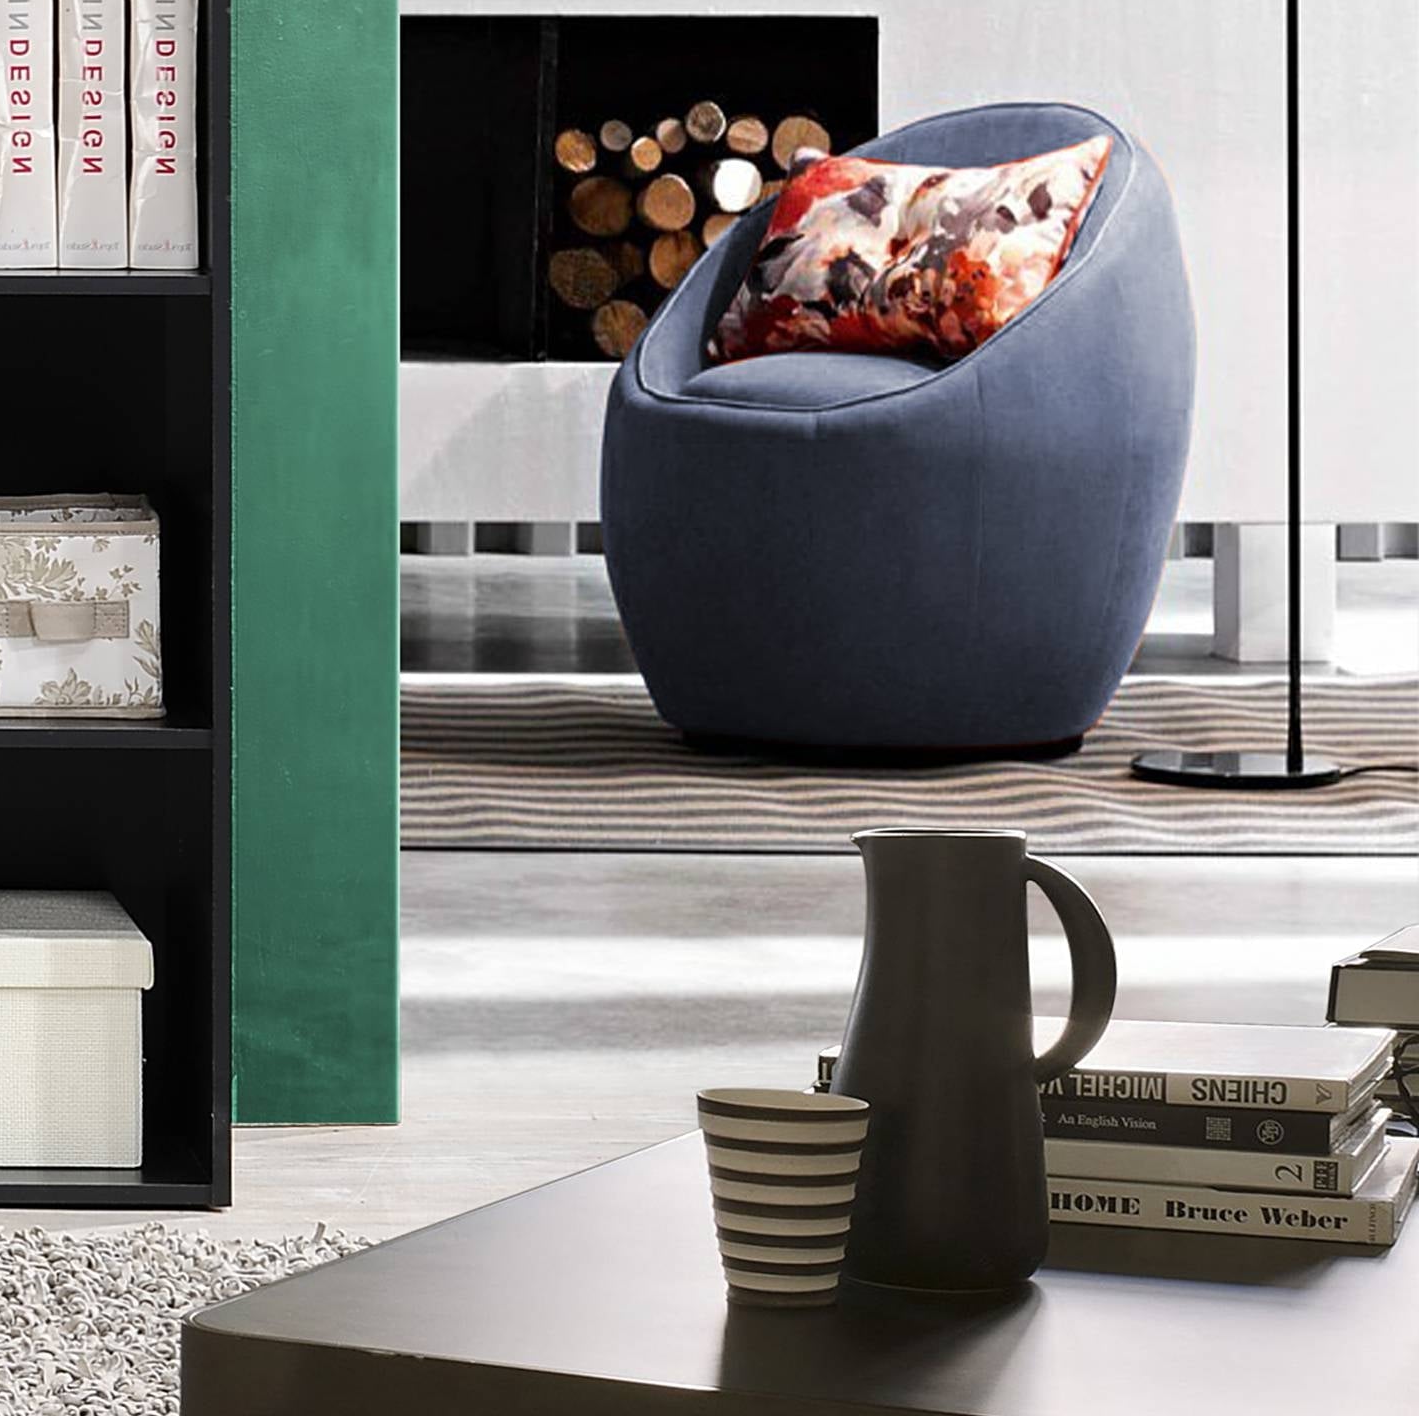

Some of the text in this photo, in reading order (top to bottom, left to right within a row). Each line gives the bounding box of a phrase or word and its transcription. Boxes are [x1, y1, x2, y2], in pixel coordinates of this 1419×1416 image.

[1068, 1073, 1164, 1100] MICHEL
[1192, 1078, 1286, 1105] CHIENS
[1058, 1113, 1157, 1129] An English Vision
[1275, 1164, 1302, 1182] 2
[1051, 1192, 1140, 1216] HOME
[1165, 1199, 1248, 1224] Bruce
[1261, 1205, 1349, 1230] Weber
